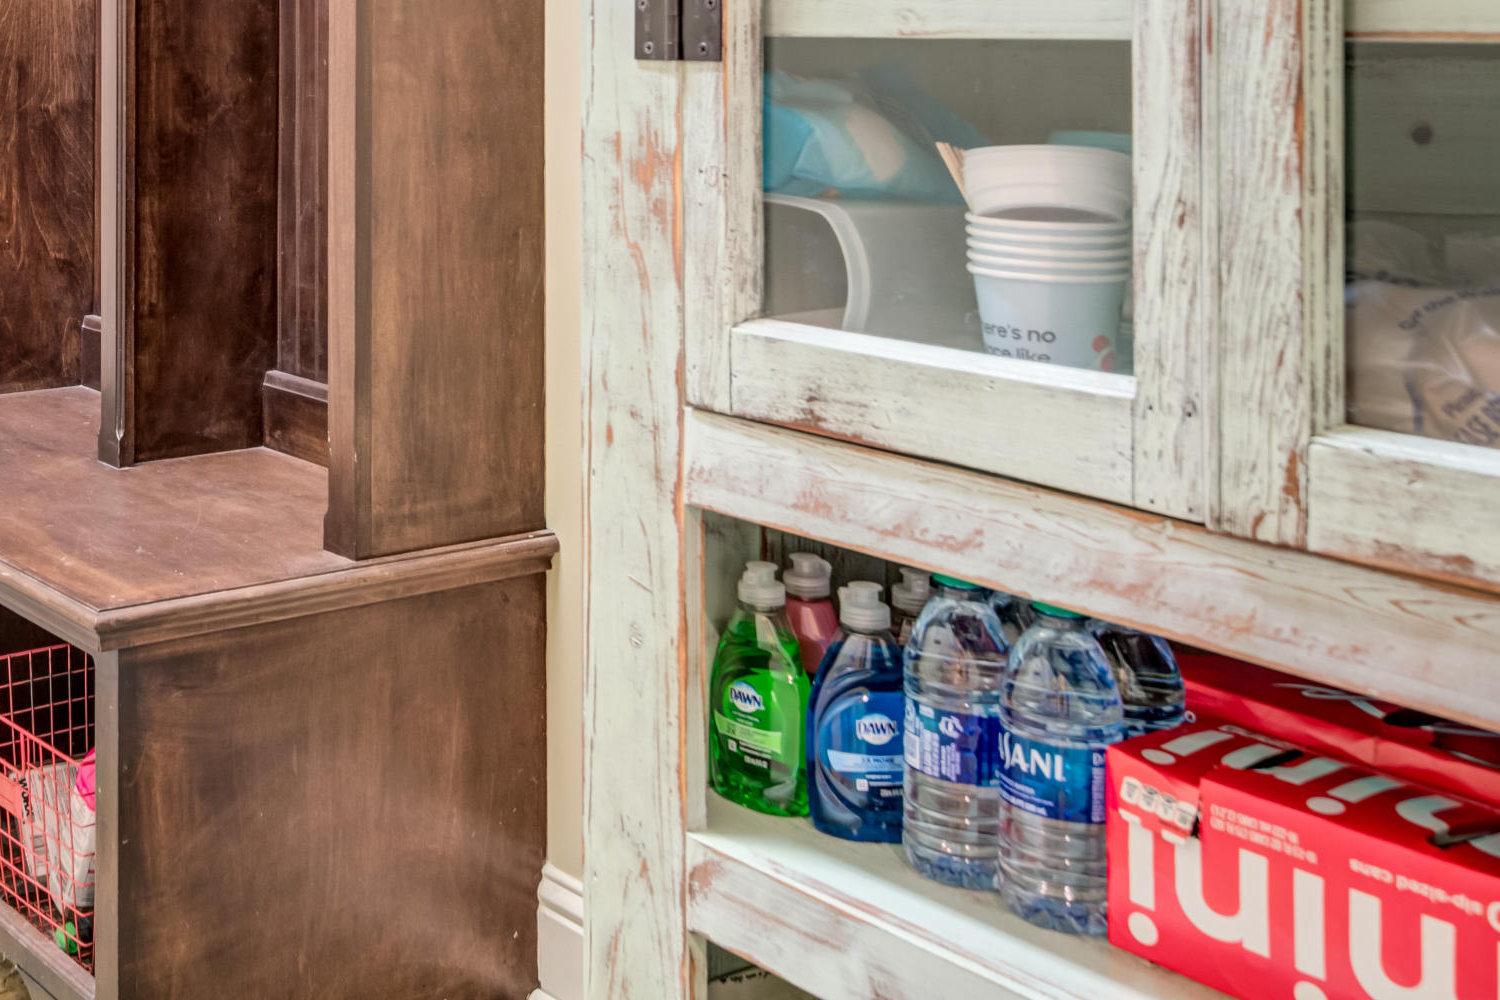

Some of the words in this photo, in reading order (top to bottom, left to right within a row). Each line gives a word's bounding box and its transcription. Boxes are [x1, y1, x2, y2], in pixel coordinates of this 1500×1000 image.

[982, 321, 1022, 340] ere's
[1028, 329, 1056, 343] no
[730, 687, 762, 707] DAWN
[858, 721, 897, 735] DAWN
[1349, 858, 1393, 884] cans
[1396, 874, 1483, 916] sip-sized
